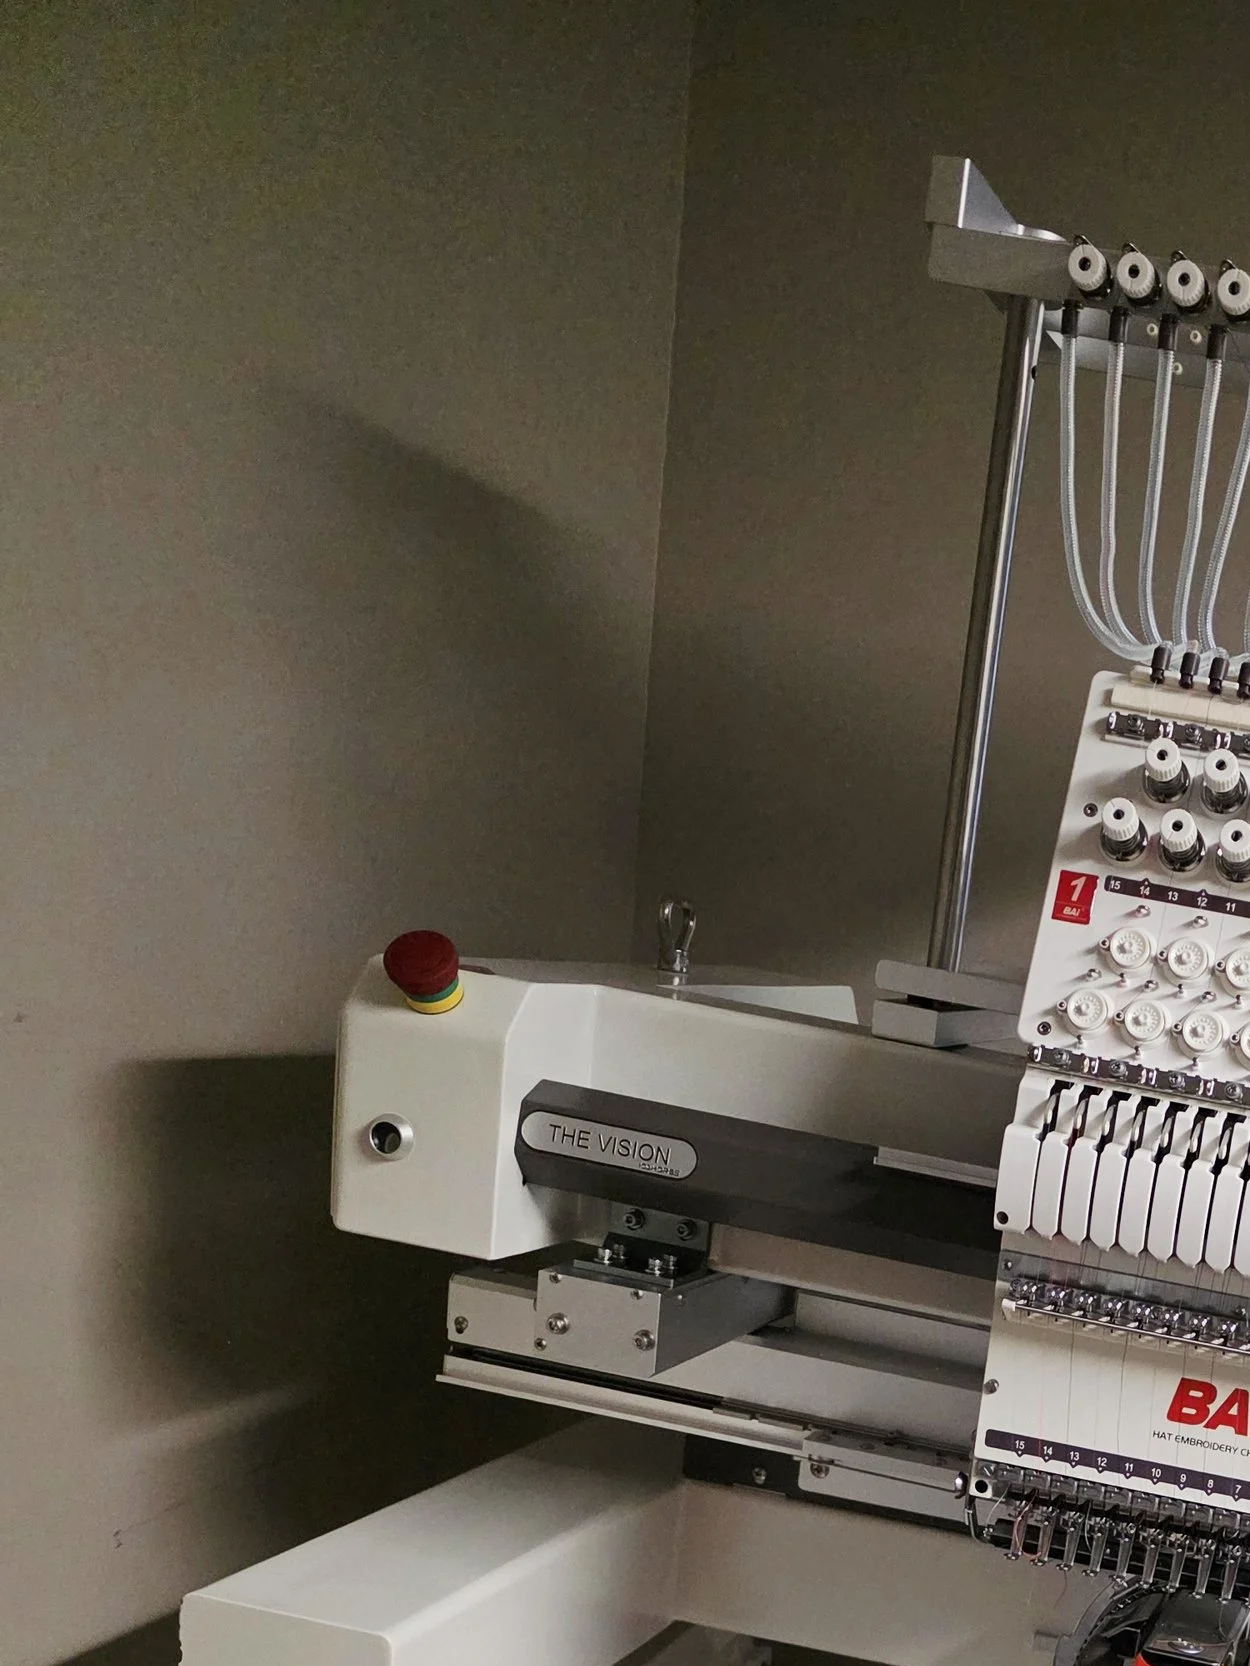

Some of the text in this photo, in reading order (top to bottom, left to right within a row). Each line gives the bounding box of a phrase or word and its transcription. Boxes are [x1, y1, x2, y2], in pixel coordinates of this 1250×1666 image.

[1070, 876, 1088, 901] 1
[1109, 880, 1121, 890] 15
[1139, 886, 1150, 896] 14
[1168, 891, 1179, 901] 13
[1197, 897, 1208, 907] 12
[1226, 903, 1236, 912] 11
[549, 1123, 672, 1166] THE VISION
[1152, 1430, 1173, 1442] HAT
[1174, 1435, 1238, 1455] EMBROIDERY
[1014, 1440, 1025, 1450] 15
[1043, 1446, 1053, 1455] 14
[1069, 1451, 1080, 1461] 13
[1096, 1457, 1107, 1467] 12
[1124, 1462, 1134, 1472] 11
[1151, 1468, 1162, 1478] 10
[1180, 1473, 1187, 1483] 9
[1207, 1479, 1214, 1488] 8
[1235, 1485, 1242, 1494] 7
